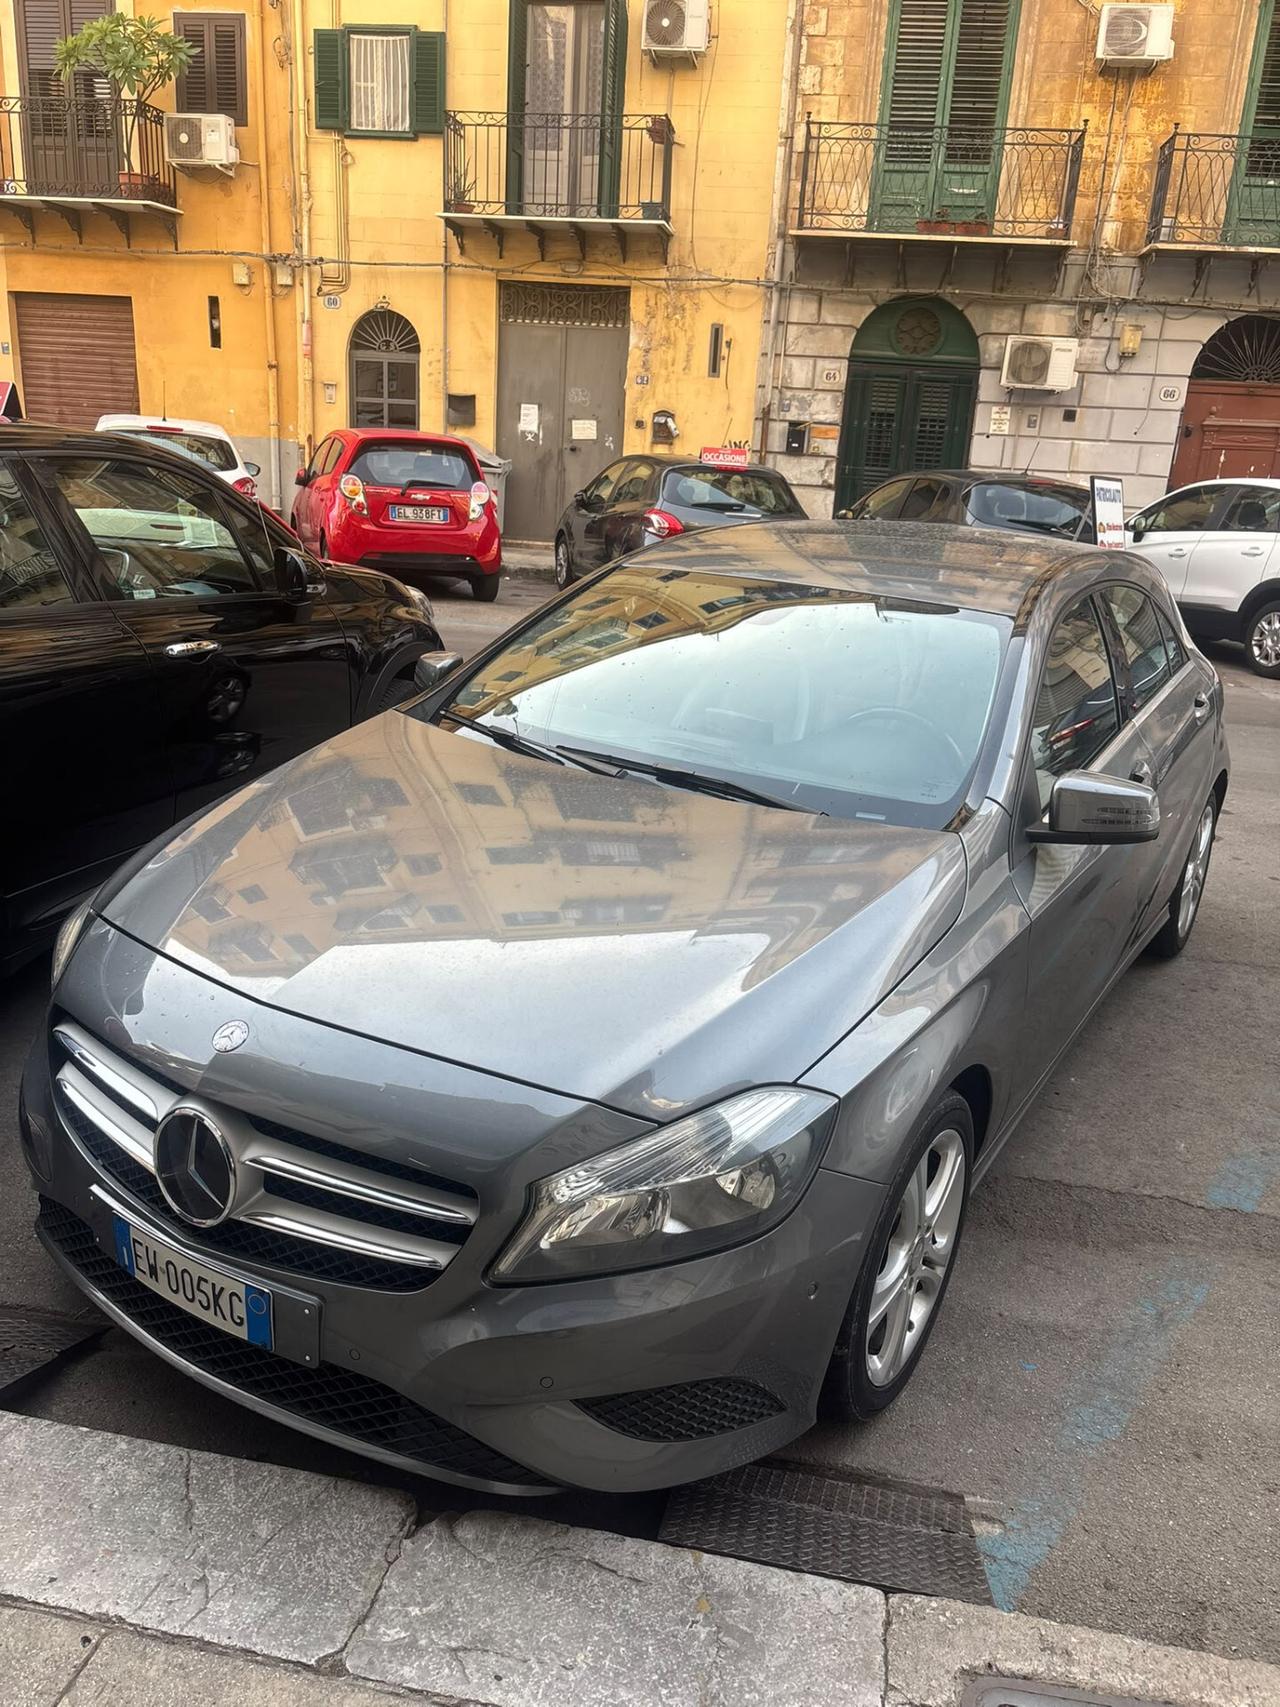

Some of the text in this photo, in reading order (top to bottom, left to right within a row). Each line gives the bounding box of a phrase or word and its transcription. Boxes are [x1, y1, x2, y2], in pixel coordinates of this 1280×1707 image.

[327, 297, 338, 307] 60
[825, 371, 837, 382] 64
[1163, 389, 1176, 400] 66
[703, 452, 746, 464] OCCASIONE
[132, 1238, 244, 1327] EW 005KG
